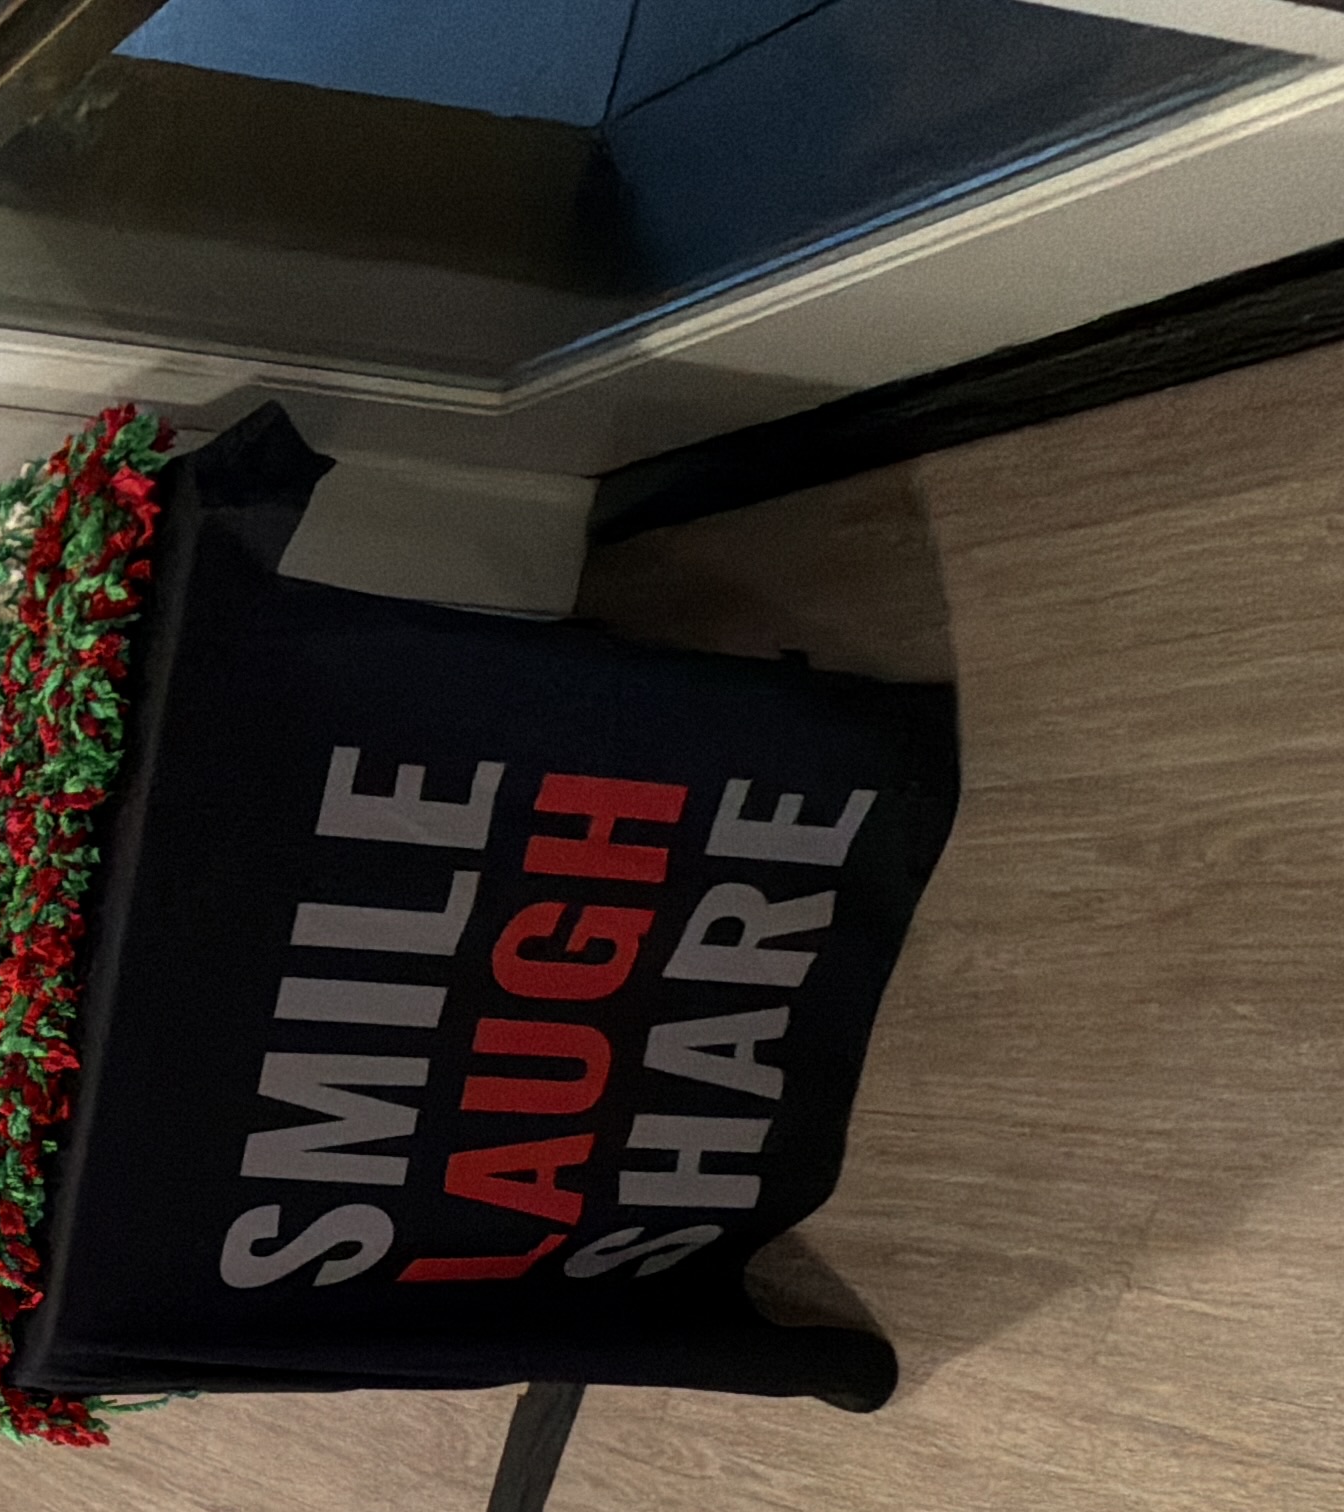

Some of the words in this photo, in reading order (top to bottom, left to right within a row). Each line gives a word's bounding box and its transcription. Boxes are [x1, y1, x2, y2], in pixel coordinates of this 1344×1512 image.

[218, 745, 506, 1289] SMILE
[395, 772, 688, 1281] LAUGH
[563, 778, 877, 1278] SHARE
